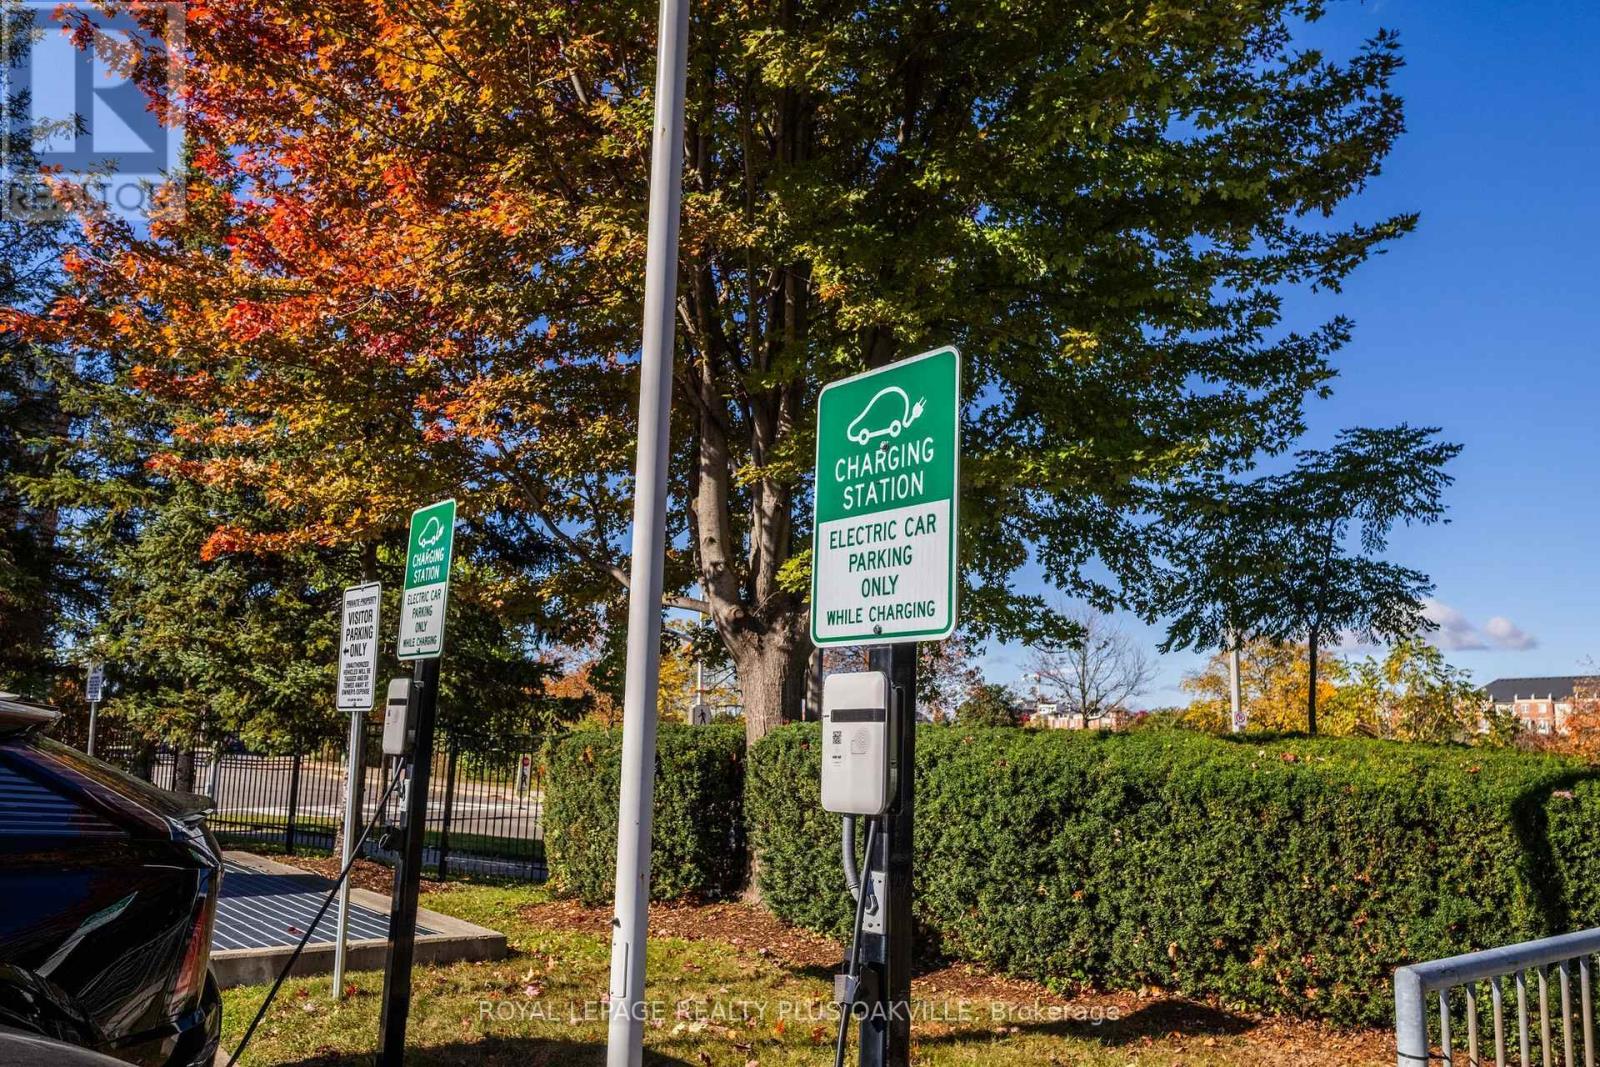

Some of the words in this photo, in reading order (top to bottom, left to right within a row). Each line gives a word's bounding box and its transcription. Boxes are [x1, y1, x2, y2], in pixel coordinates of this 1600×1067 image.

[835, 437, 934, 482] CHARGING
[843, 470, 924, 510] STATION
[829, 520, 897, 550] ELECTRIC
[904, 513, 937, 538] CAR
[412, 547, 445, 568] CHARGING
[848, 545, 913, 573] PARKING
[413, 565, 440, 584] STATION
[861, 574, 899, 598] ONLY
[407, 591, 430, 605] ELECTRIC
[430, 588, 441, 601] CAR
[348, 609, 373, 625] VISITOR
[412, 605, 433, 619] PARKING
[826, 607, 863, 626] WHILE
[868, 600, 936, 622] CHARGING
[345, 625, 373, 641] PARKING
[415, 621, 428, 633] ONLY
[350, 642, 367, 657] ONLY
[403, 638, 416, 648] WHILE
[416, 635, 438, 646] CHARGING
